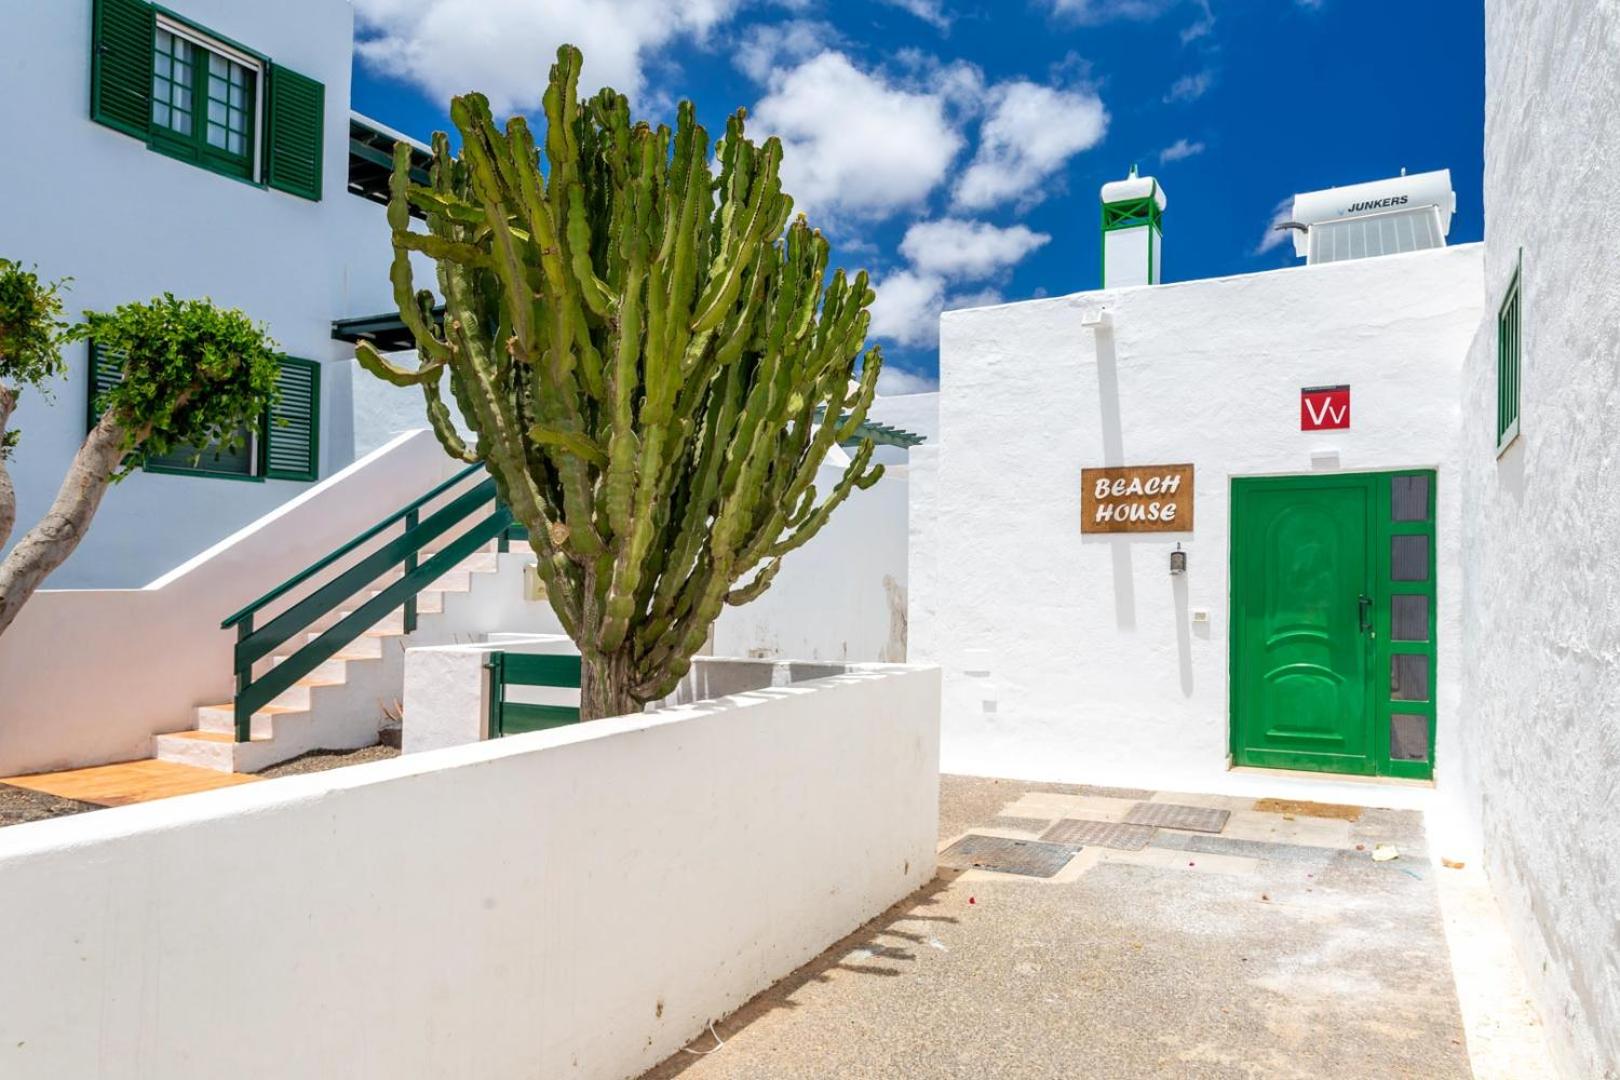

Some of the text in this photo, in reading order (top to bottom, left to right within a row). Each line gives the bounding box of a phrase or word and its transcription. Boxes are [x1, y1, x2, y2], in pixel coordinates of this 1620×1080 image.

[1347, 195, 1409, 213] JUNKERS
[1094, 475, 1182, 500] BEACH
[1095, 502, 1177, 522] HOUSE
